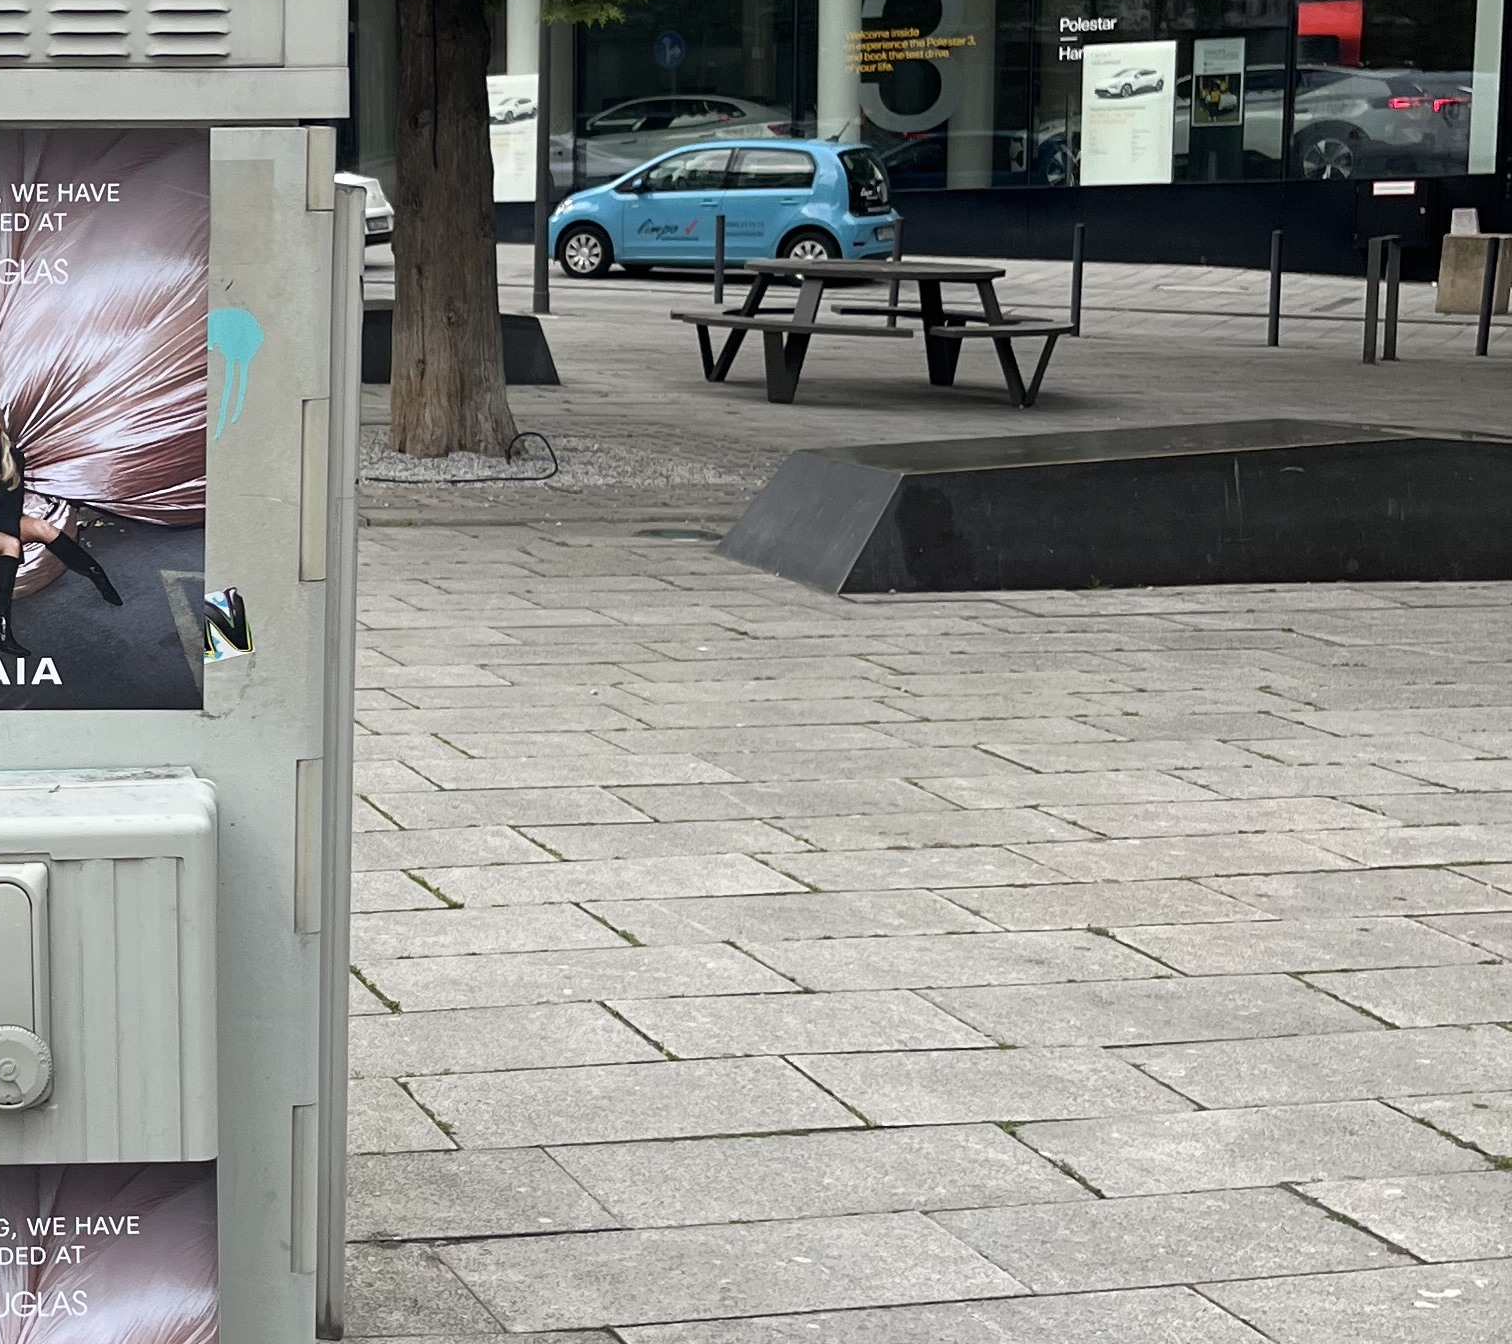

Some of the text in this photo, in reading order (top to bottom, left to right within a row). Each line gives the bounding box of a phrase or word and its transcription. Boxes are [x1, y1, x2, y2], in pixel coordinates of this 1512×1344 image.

[890, 27, 920, 37] inside
[1059, 17, 1117, 33] Polestar
[909, 39, 925, 48] the
[926, 37, 965, 47] Polestar
[863, 51, 887, 61] book
[888, 50, 904, 60] the
[905, 50, 923, 59] test
[924, 49, 950, 58] drive
[855, 64, 876, 74] your
[11, 183, 49, 202] WE
[58, 183, 120, 202] HAVE
[38, 212, 68, 232] AT
[26, 1216, 66, 1236] WE
[75, 1216, 140, 1235] HAVE
[55, 1245, 85, 1264] AT
